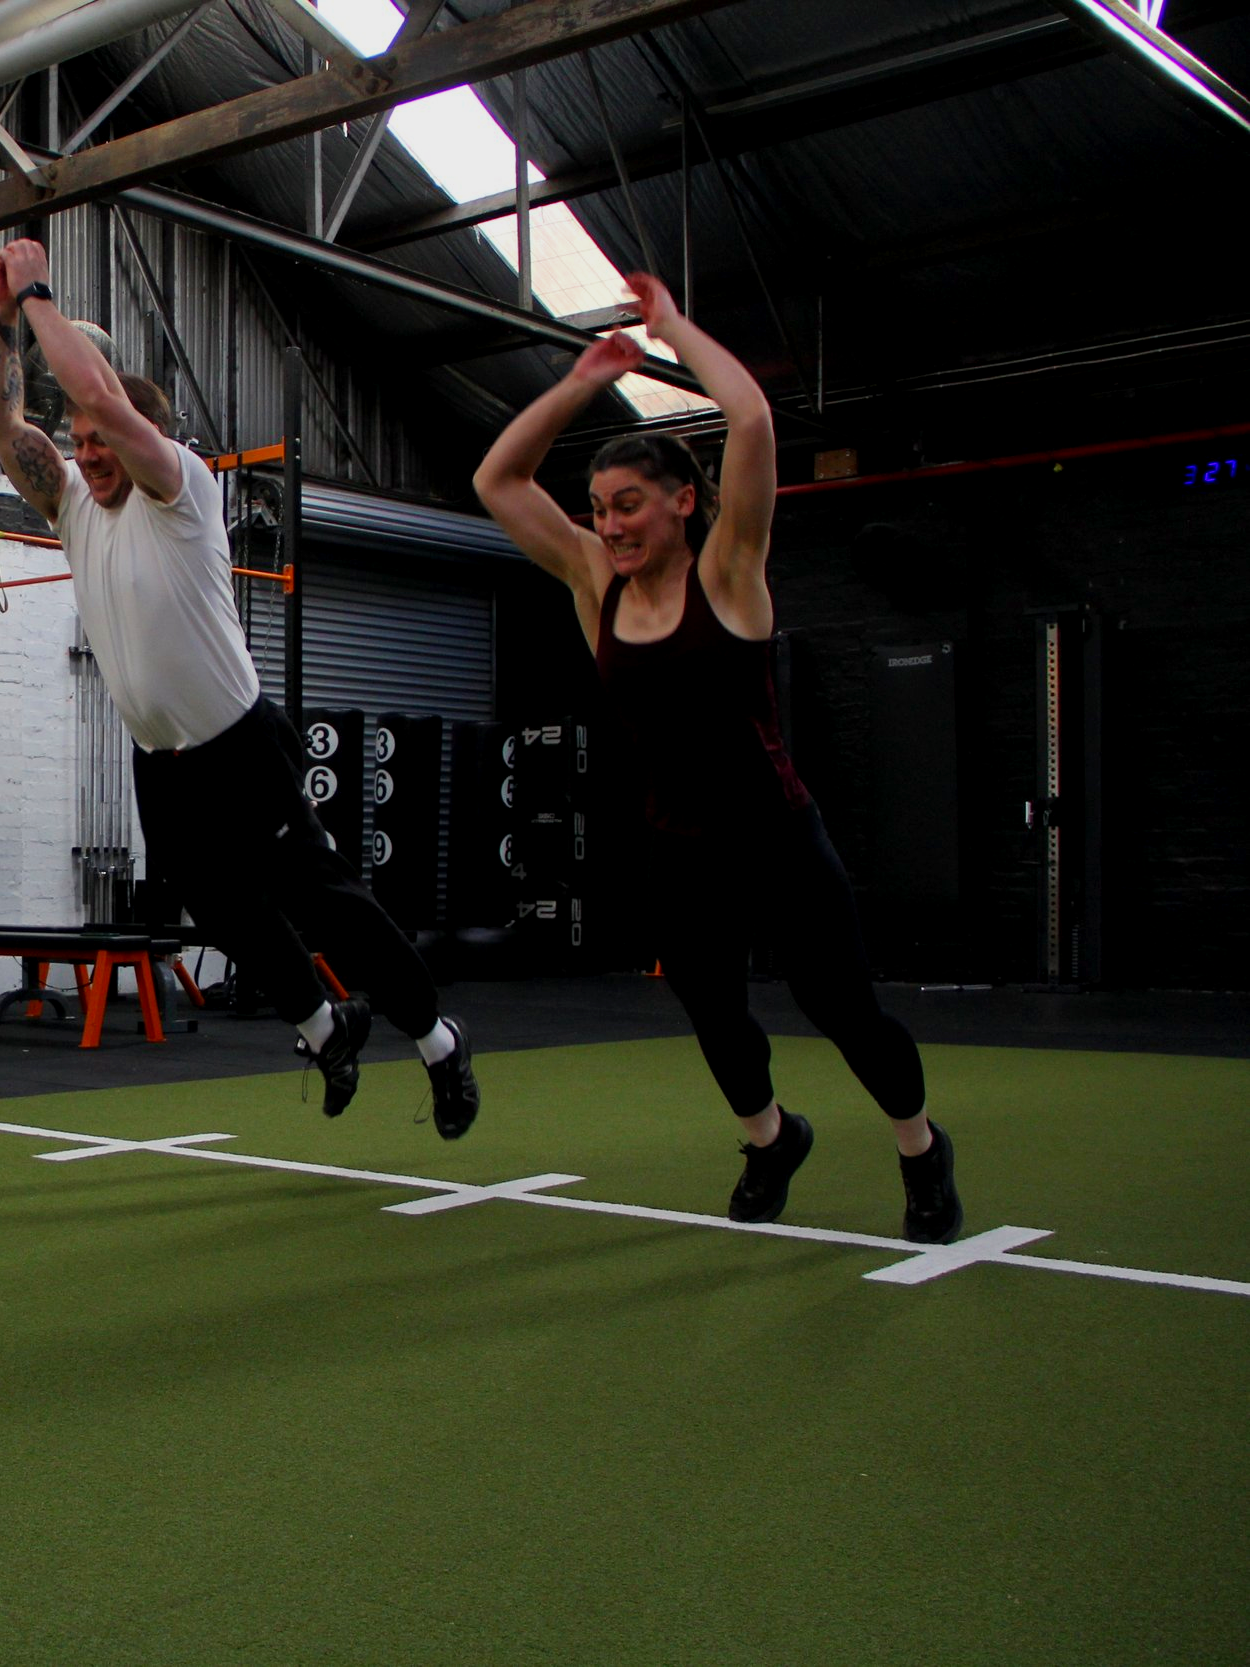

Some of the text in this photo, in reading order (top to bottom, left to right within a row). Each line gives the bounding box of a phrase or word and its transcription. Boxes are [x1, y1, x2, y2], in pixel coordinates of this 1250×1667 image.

[311, 725, 330, 756] 3
[377, 730, 389, 760] 3
[521, 725, 563, 746] 24
[311, 768, 330, 799] 6
[376, 771, 387, 801] 6
[374, 832, 386, 862] 9
[516, 899, 558, 920] 24
